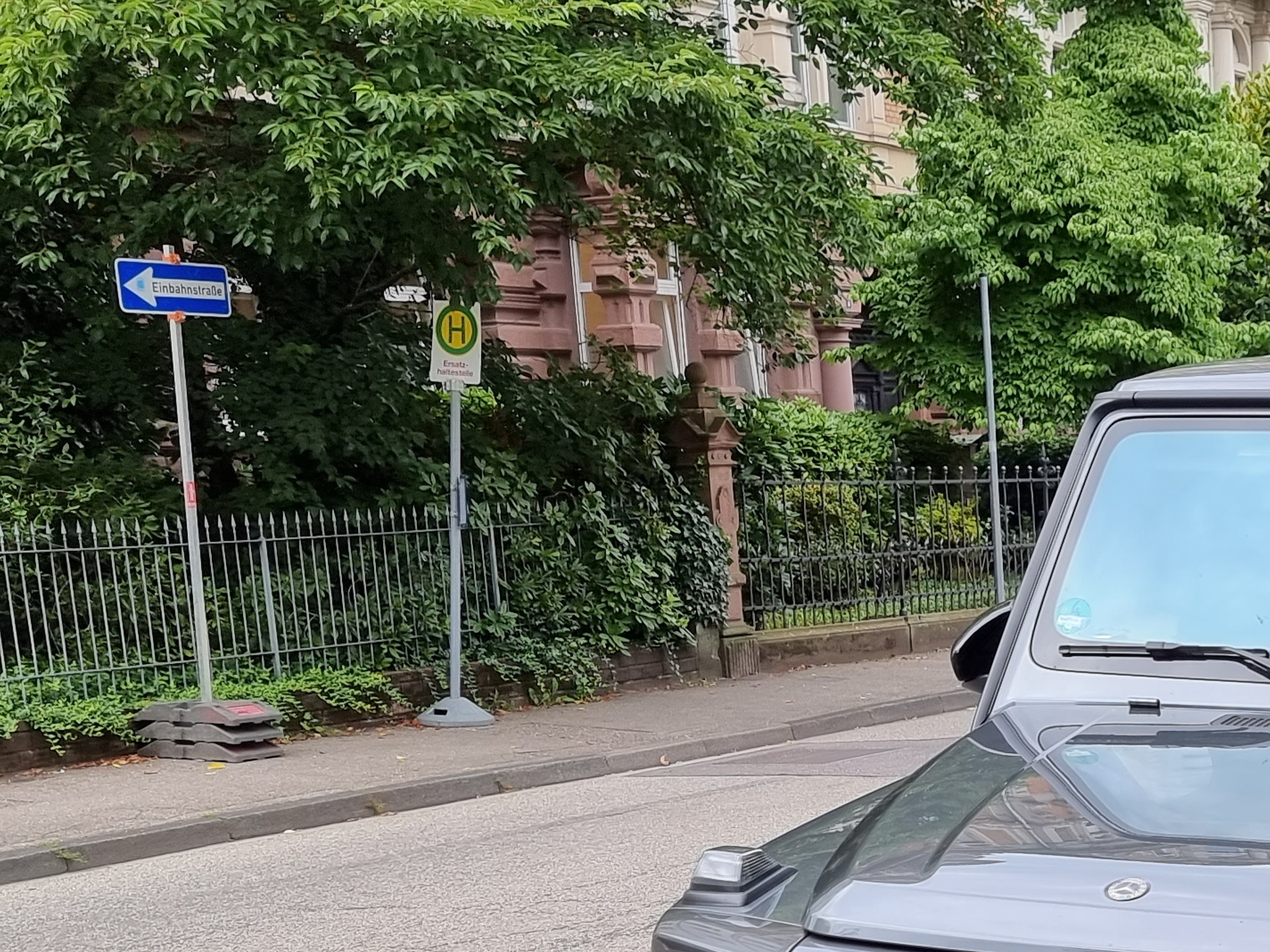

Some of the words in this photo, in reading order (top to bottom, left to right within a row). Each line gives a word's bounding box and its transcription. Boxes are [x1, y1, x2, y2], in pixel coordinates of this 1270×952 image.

[151, 281, 223, 297] Einbahnstraße
[448, 315, 466, 344] H
[443, 360, 469, 369] Ersatz-
